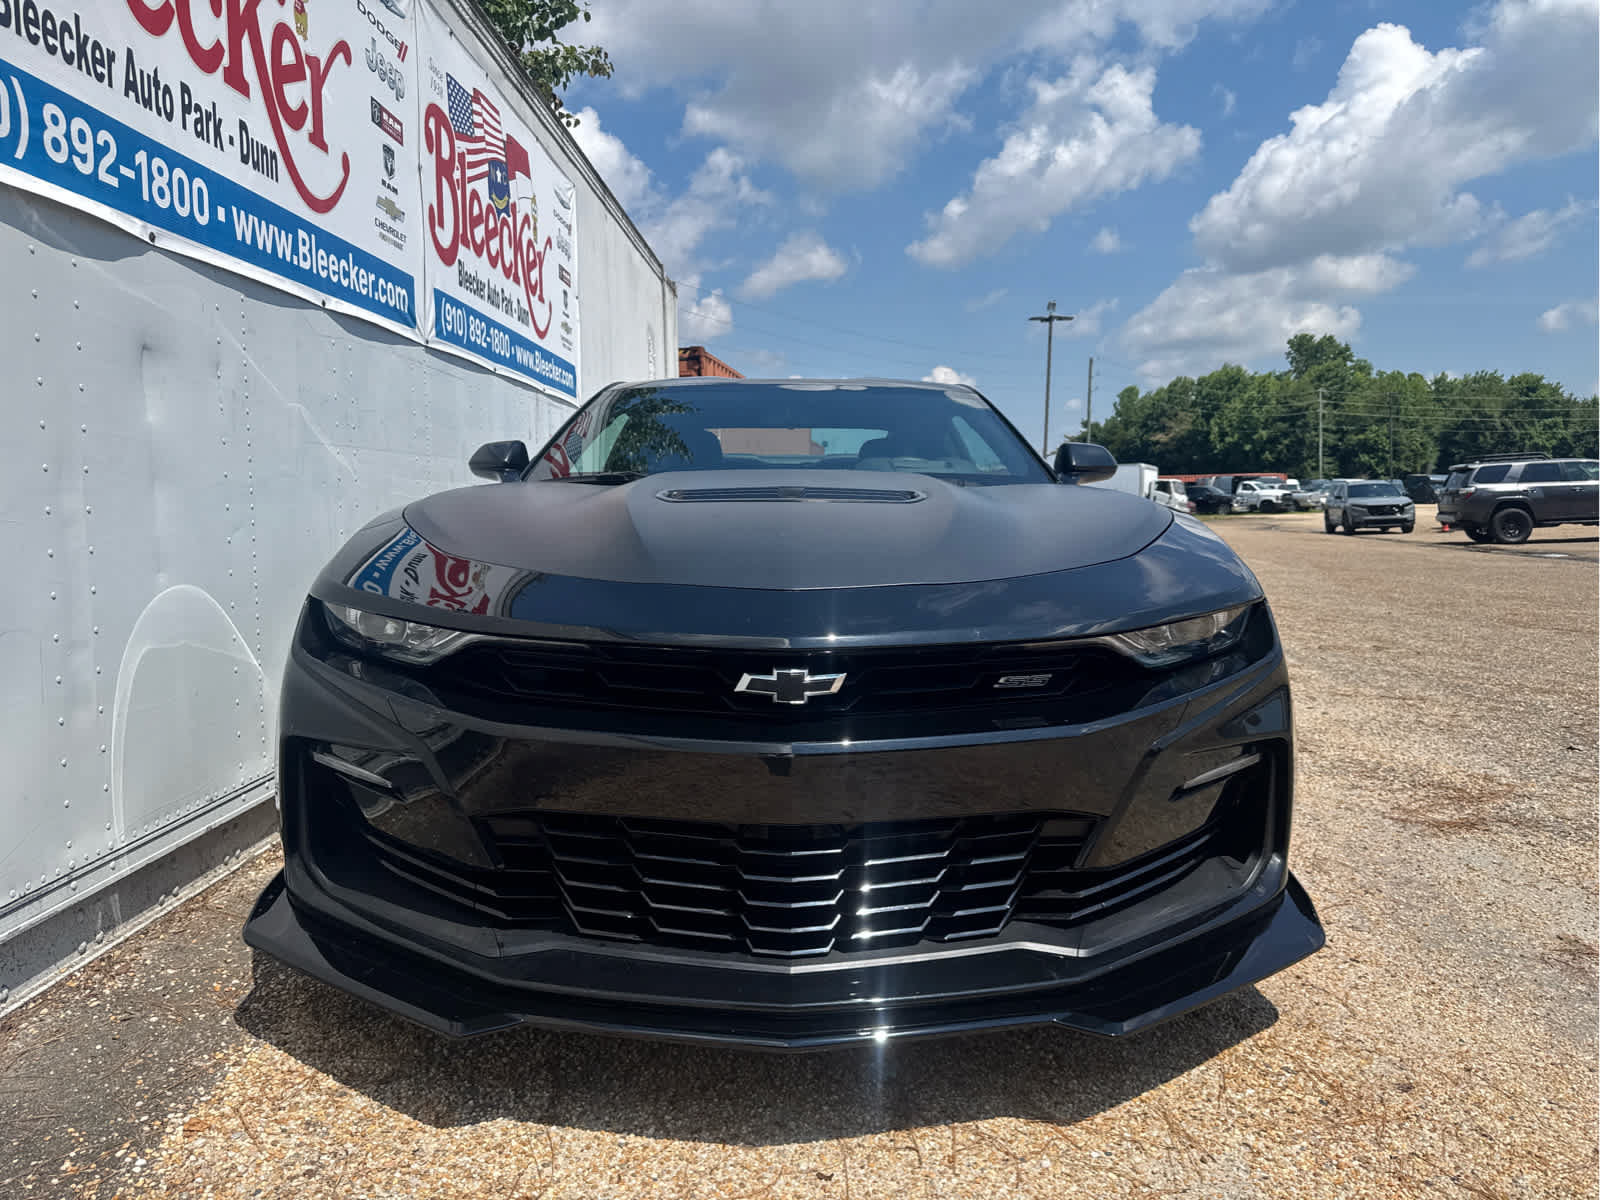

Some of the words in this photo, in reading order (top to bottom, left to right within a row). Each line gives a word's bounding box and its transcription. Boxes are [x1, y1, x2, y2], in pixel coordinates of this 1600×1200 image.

[357, 0, 401, 51] DODGE
[365, 37, 405, 102] Jeep
[123, 46, 174, 123] Auto
[179, 80, 225, 152] Park
[238, 118, 279, 183] Dunn
[42, 102, 210, 226] 892-1800
[231, 205, 409, 314] www.Bleecker.com
[374, 217, 408, 243] CHEVROLET
[424, 102, 553, 341] Bleecker
[457, 258, 487, 303] Bleecker
[487, 278, 501, 311] Auto
[500, 287, 514, 318] Park
[441, 297, 468, 345] (910)
[469, 315, 511, 359] 892-1800
[515, 344, 575, 391] www.Bleecker.com
